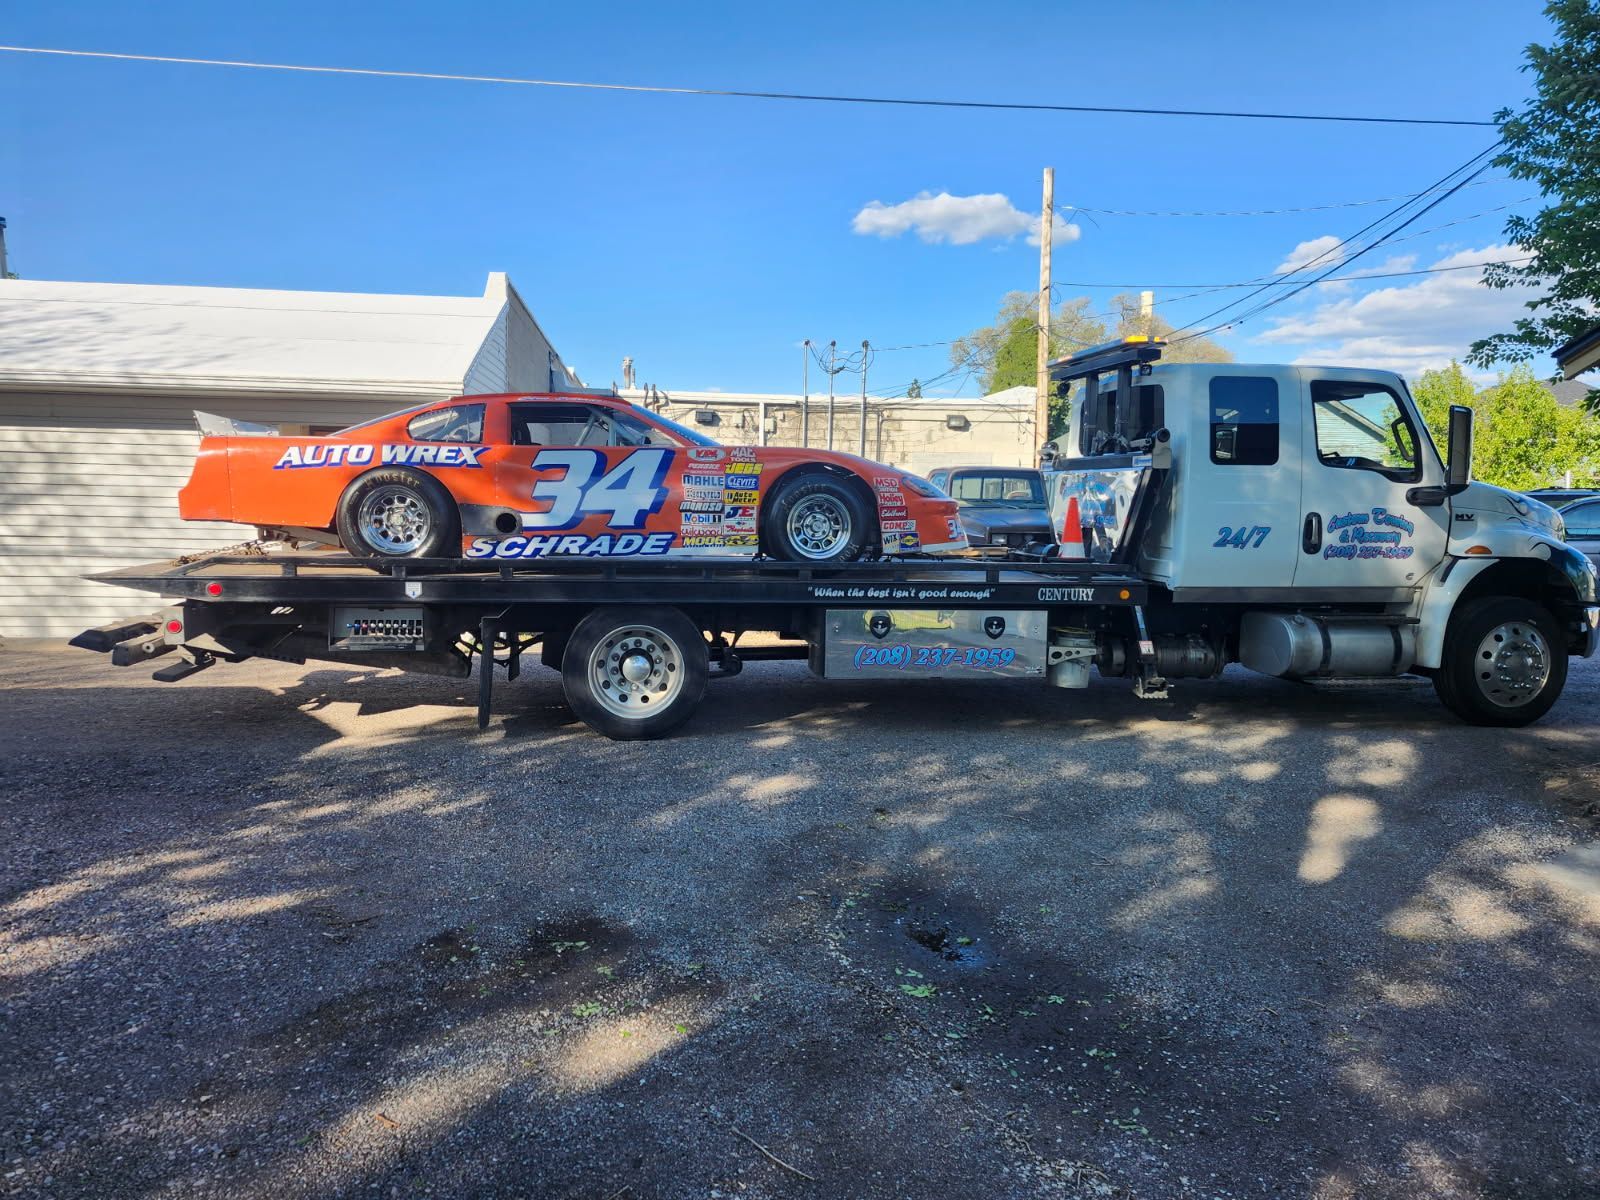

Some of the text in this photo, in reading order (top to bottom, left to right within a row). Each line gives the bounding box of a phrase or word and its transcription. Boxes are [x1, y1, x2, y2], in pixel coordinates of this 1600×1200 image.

[273, 444, 490, 469] AUTO WREX
[730, 447, 757, 457] MAC
[683, 475, 724, 487] MAHLE
[875, 478, 897, 488] MSD
[520, 448, 676, 532] 34
[684, 514, 710, 523] Mobil
[1455, 513, 1475, 522] MV
[1212, 525, 1272, 550] 24/7
[464, 532, 678, 559] SCHRADE
[847, 587, 865, 598] the
[867, 587, 890, 598] best
[892, 587, 916, 598] isn't
[918, 587, 947, 600] good
[1037, 586, 1095, 601] CENTURY
[854, 644, 1016, 671] (208) 237-1959
